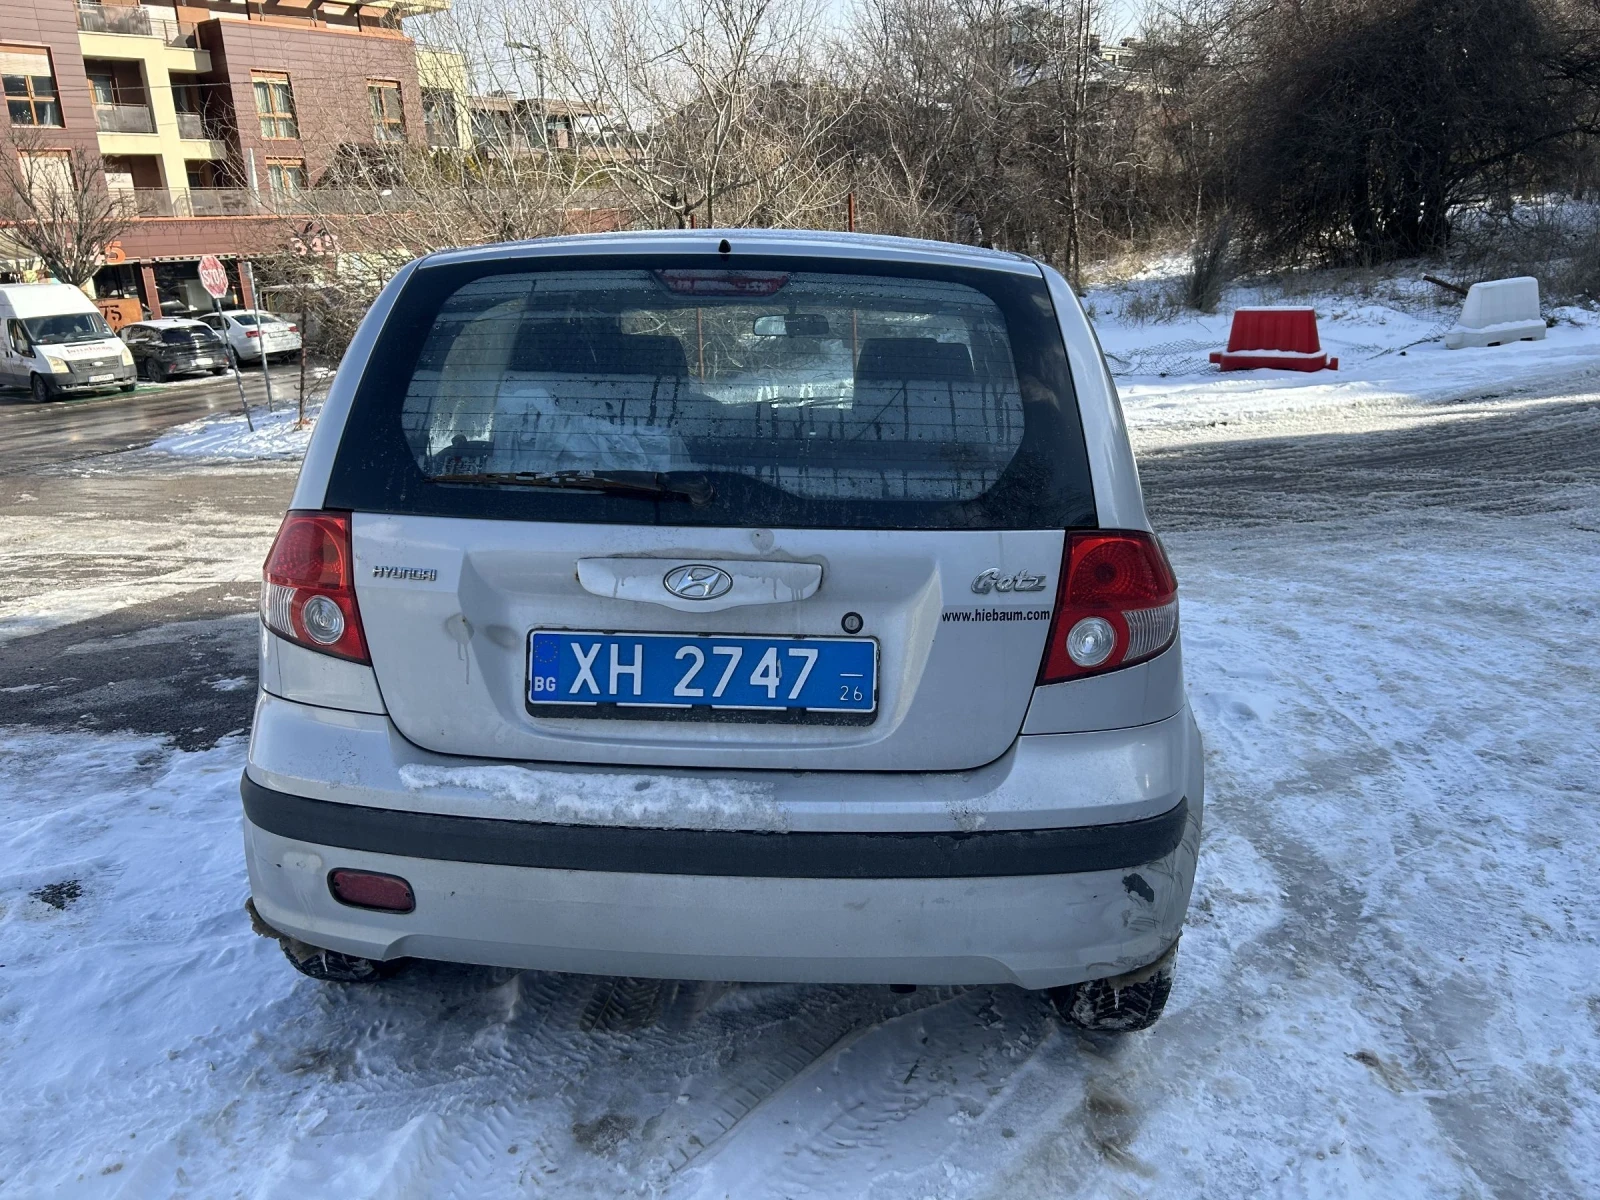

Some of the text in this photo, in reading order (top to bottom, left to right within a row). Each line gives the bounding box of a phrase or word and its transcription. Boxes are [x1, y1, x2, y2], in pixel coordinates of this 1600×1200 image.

[201, 268, 226, 286] STOP
[373, 566, 437, 581] HYUNDAI
[971, 567, 1046, 594] Getz
[942, 609, 1050, 622] www.hiebaum.com
[569, 642, 819, 699] XH 2747
[534, 676, 557, 692] BG
[839, 685, 863, 701] 26
